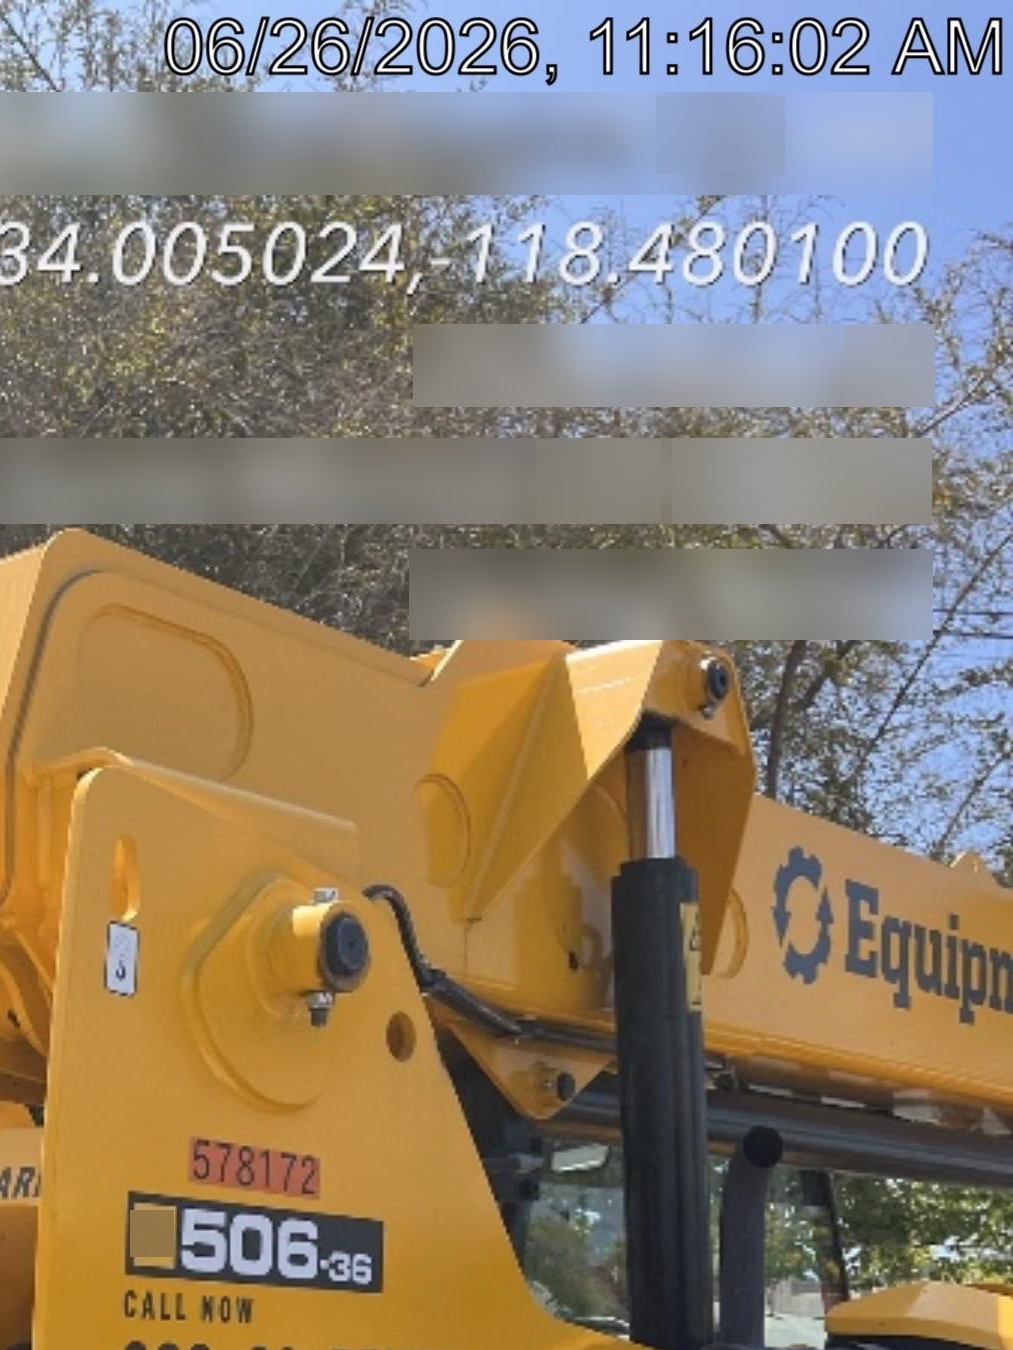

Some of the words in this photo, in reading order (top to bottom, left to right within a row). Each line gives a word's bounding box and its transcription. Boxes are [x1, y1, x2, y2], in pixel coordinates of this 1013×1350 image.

[192, 1138, 318, 1196] 578172
[124, 1290, 186, 1321] CALL
[201, 1296, 254, 1324] NOW
